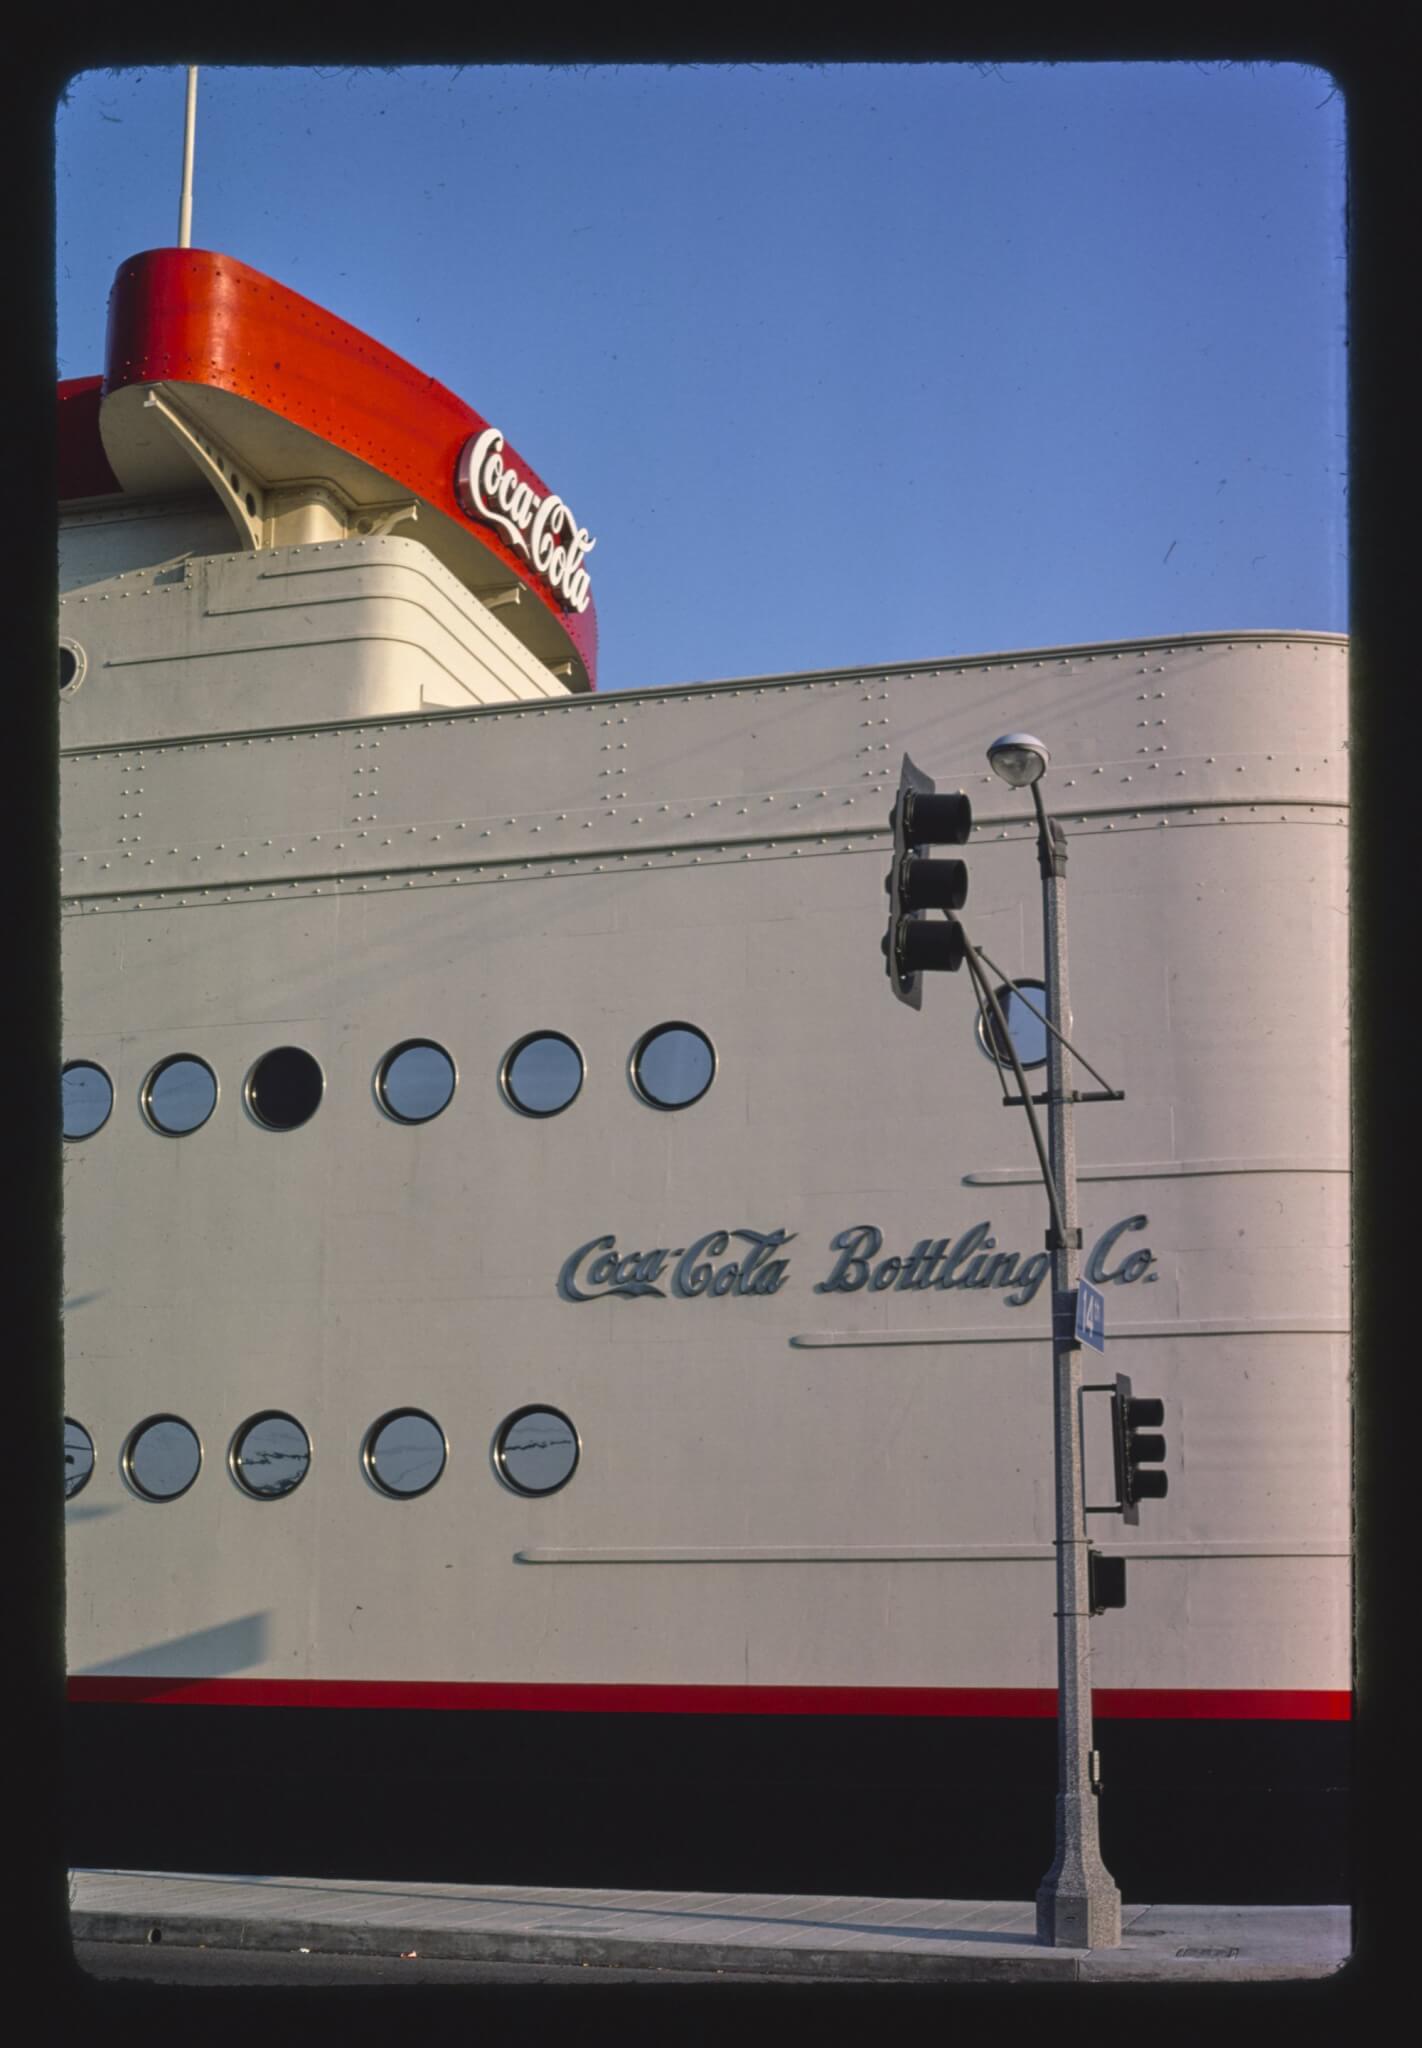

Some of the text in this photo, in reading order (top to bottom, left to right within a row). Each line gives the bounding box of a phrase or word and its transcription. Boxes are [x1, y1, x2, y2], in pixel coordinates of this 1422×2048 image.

[469, 428, 597, 613] Coca-Cola
[558, 1214, 1159, 1307] Coca-Cola Bottling Co.
